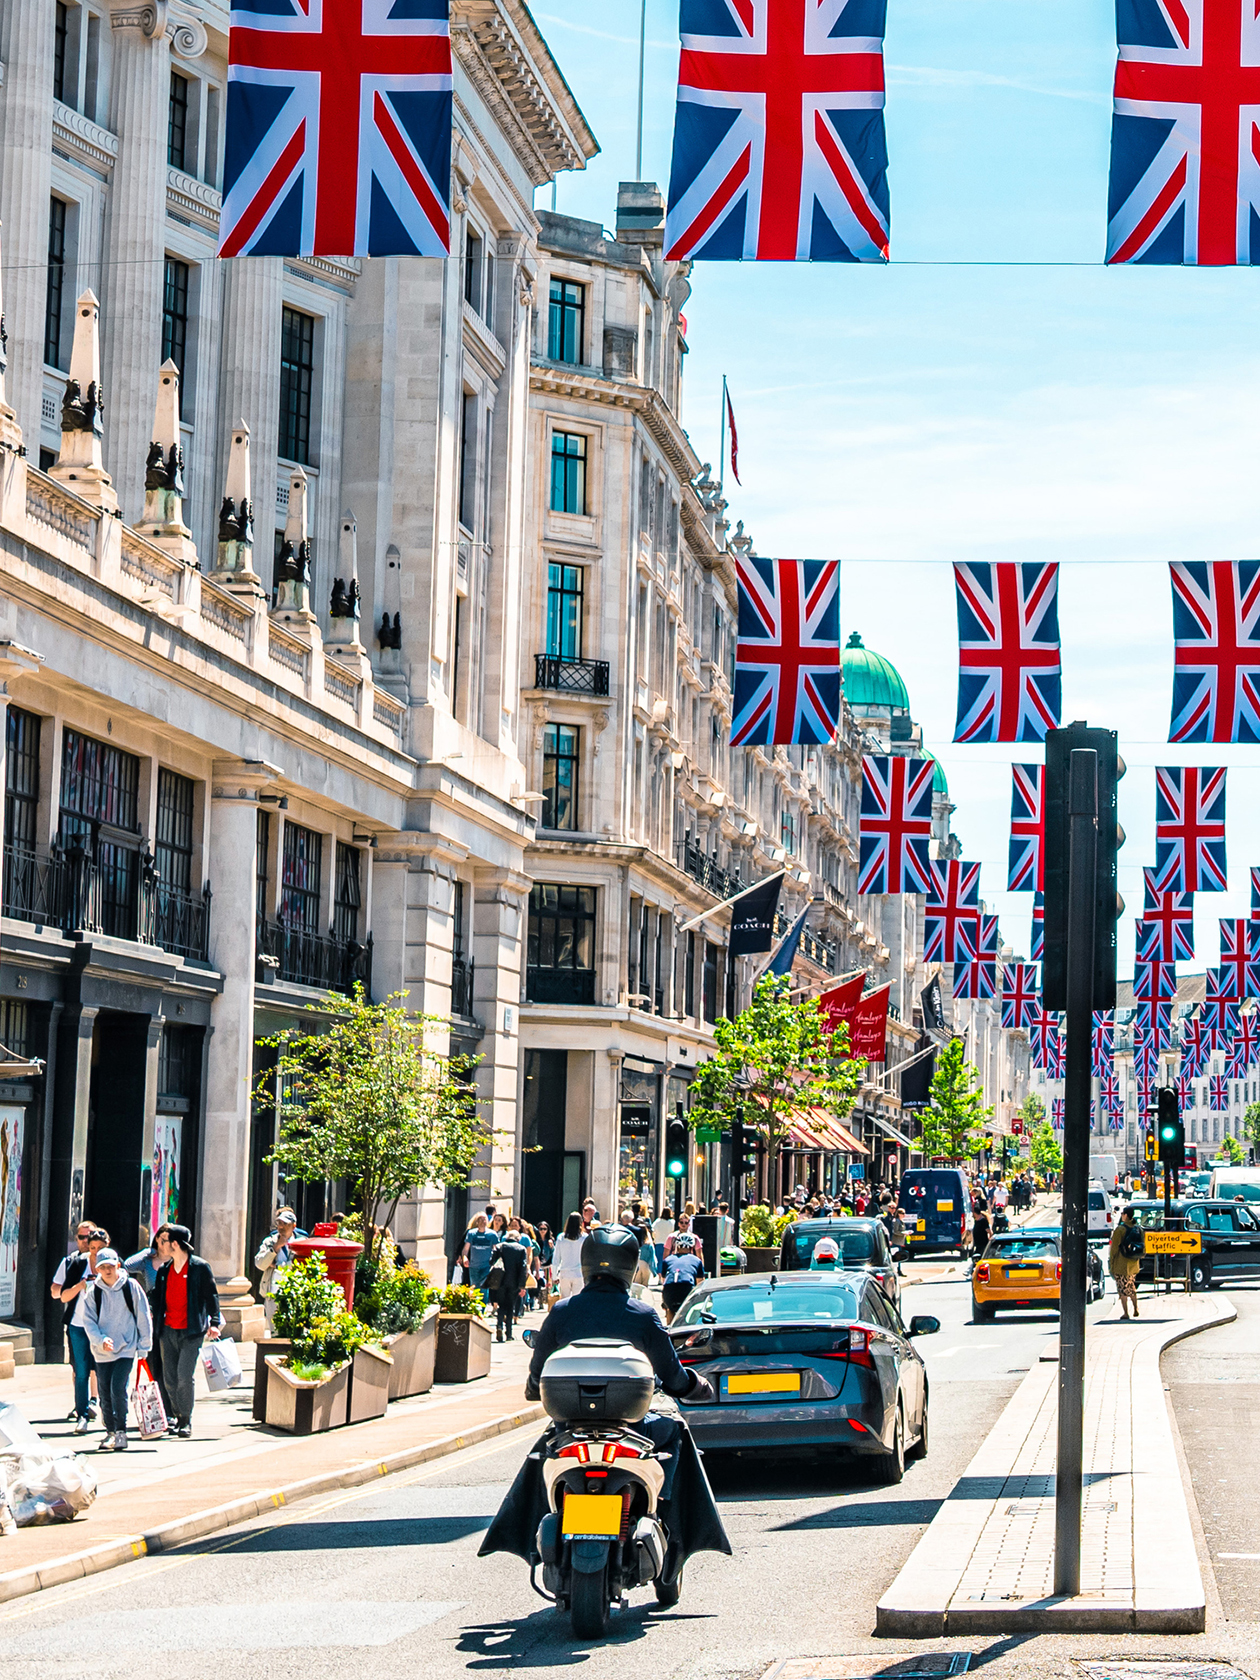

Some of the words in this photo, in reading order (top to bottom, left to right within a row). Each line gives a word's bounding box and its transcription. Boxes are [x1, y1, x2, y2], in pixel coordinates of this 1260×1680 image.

[733, 922, 770, 930] COACH
[854, 1010, 883, 1025] Hamleys
[853, 1028, 882, 1042] Hamleys
